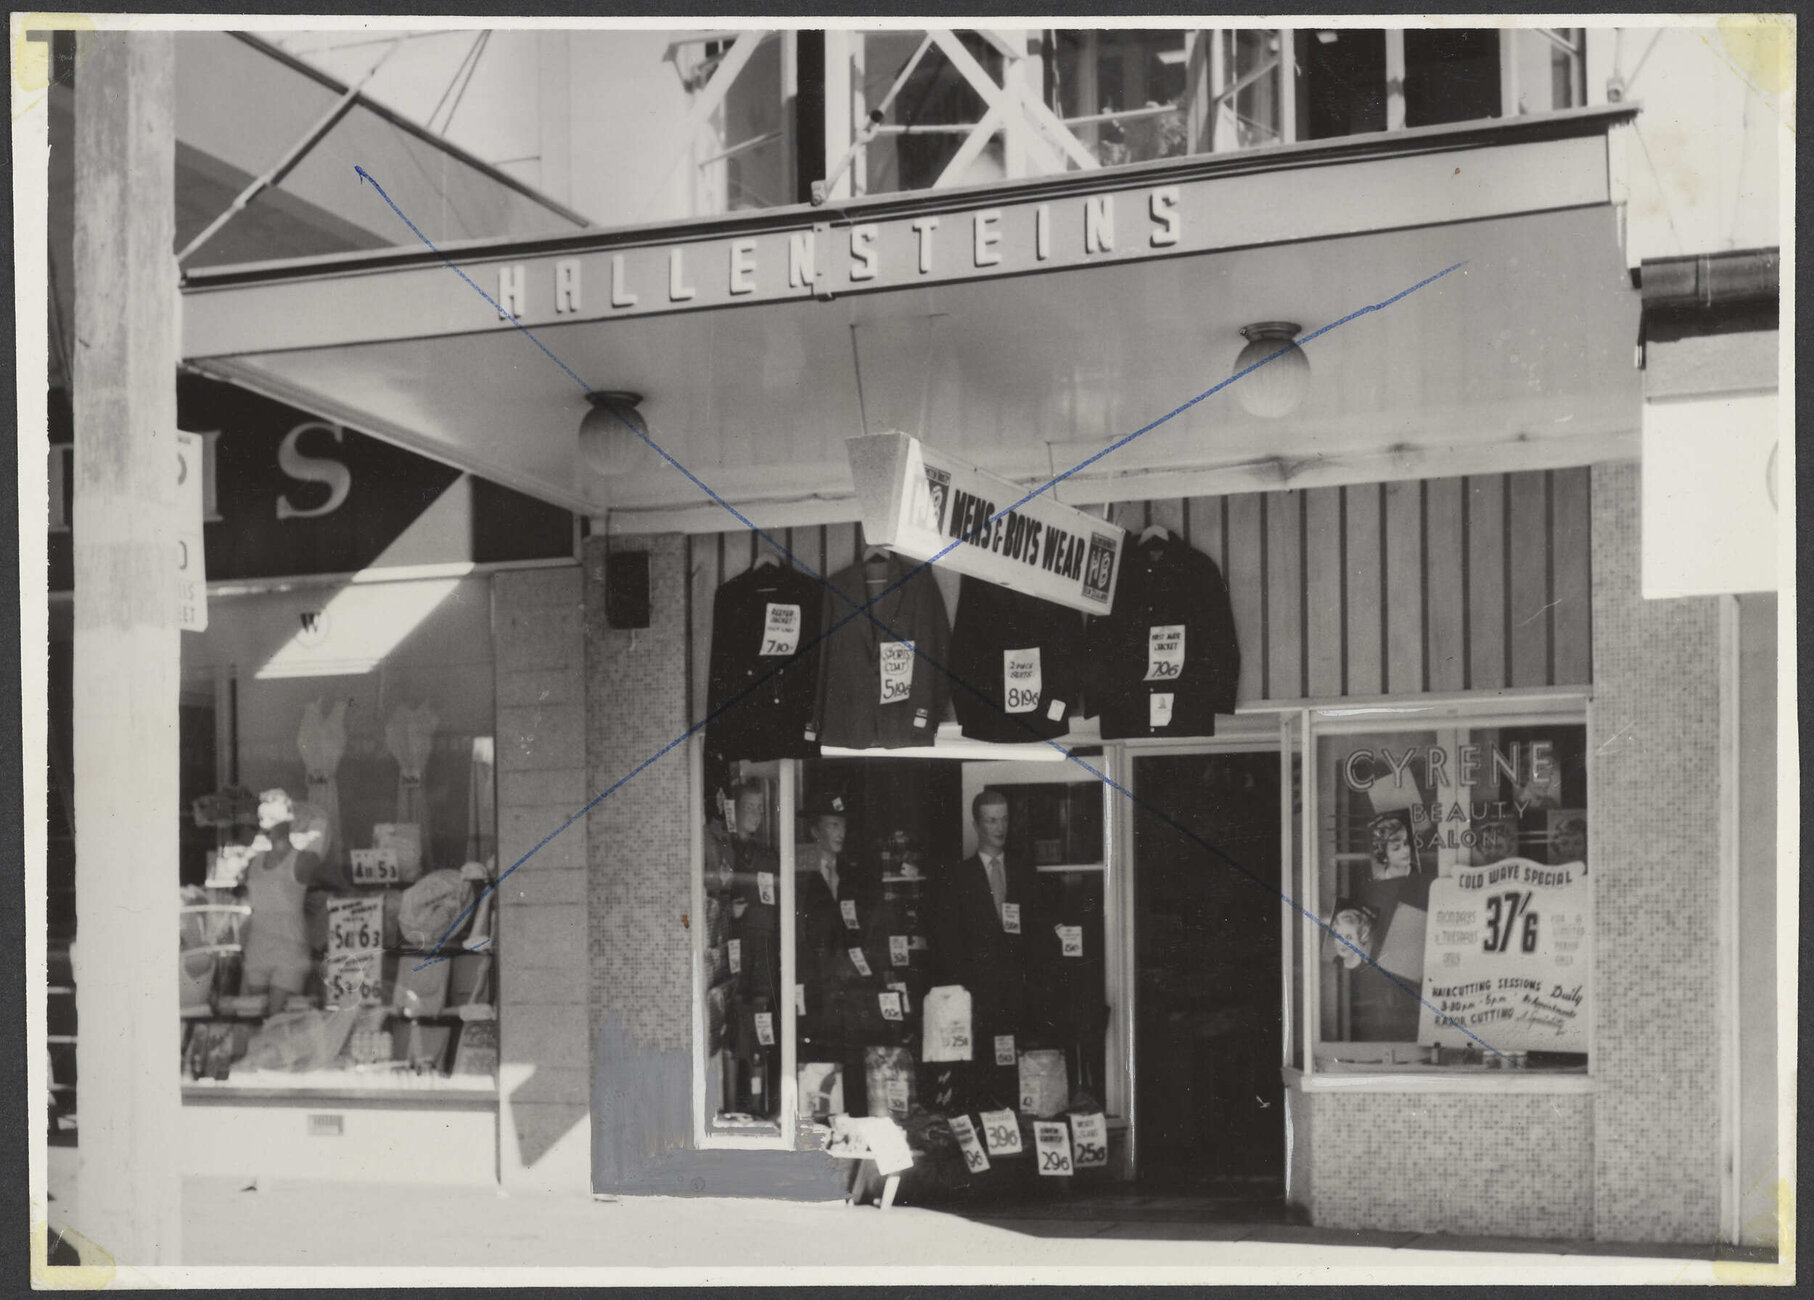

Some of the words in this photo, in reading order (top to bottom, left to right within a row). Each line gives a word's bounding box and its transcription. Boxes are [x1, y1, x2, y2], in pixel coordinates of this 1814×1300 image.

[497, 186, 1183, 322] HALLENSTEINS
[949, 489, 996, 549] MENS
[1003, 510, 1043, 566] BOYS
[1042, 525, 1086, 582] WEAR
[1344, 740, 1555, 793] CYRENE
[1411, 800, 1531, 824] BEAUTY
[1411, 829, 1499, 850] SALON
[1458, 873, 1485, 889] COLD
[1488, 865, 1520, 884] WAVE
[1524, 867, 1573, 887] SPECIAL
[1432, 979, 1492, 998] HAIRCUTTING
[1498, 977, 1543, 992] SESSIONS
[1550, 984, 1583, 1008] Daily
[1470, 1007, 1515, 1025] CUTTING
[1042, 1151, 1070, 1171] 296
